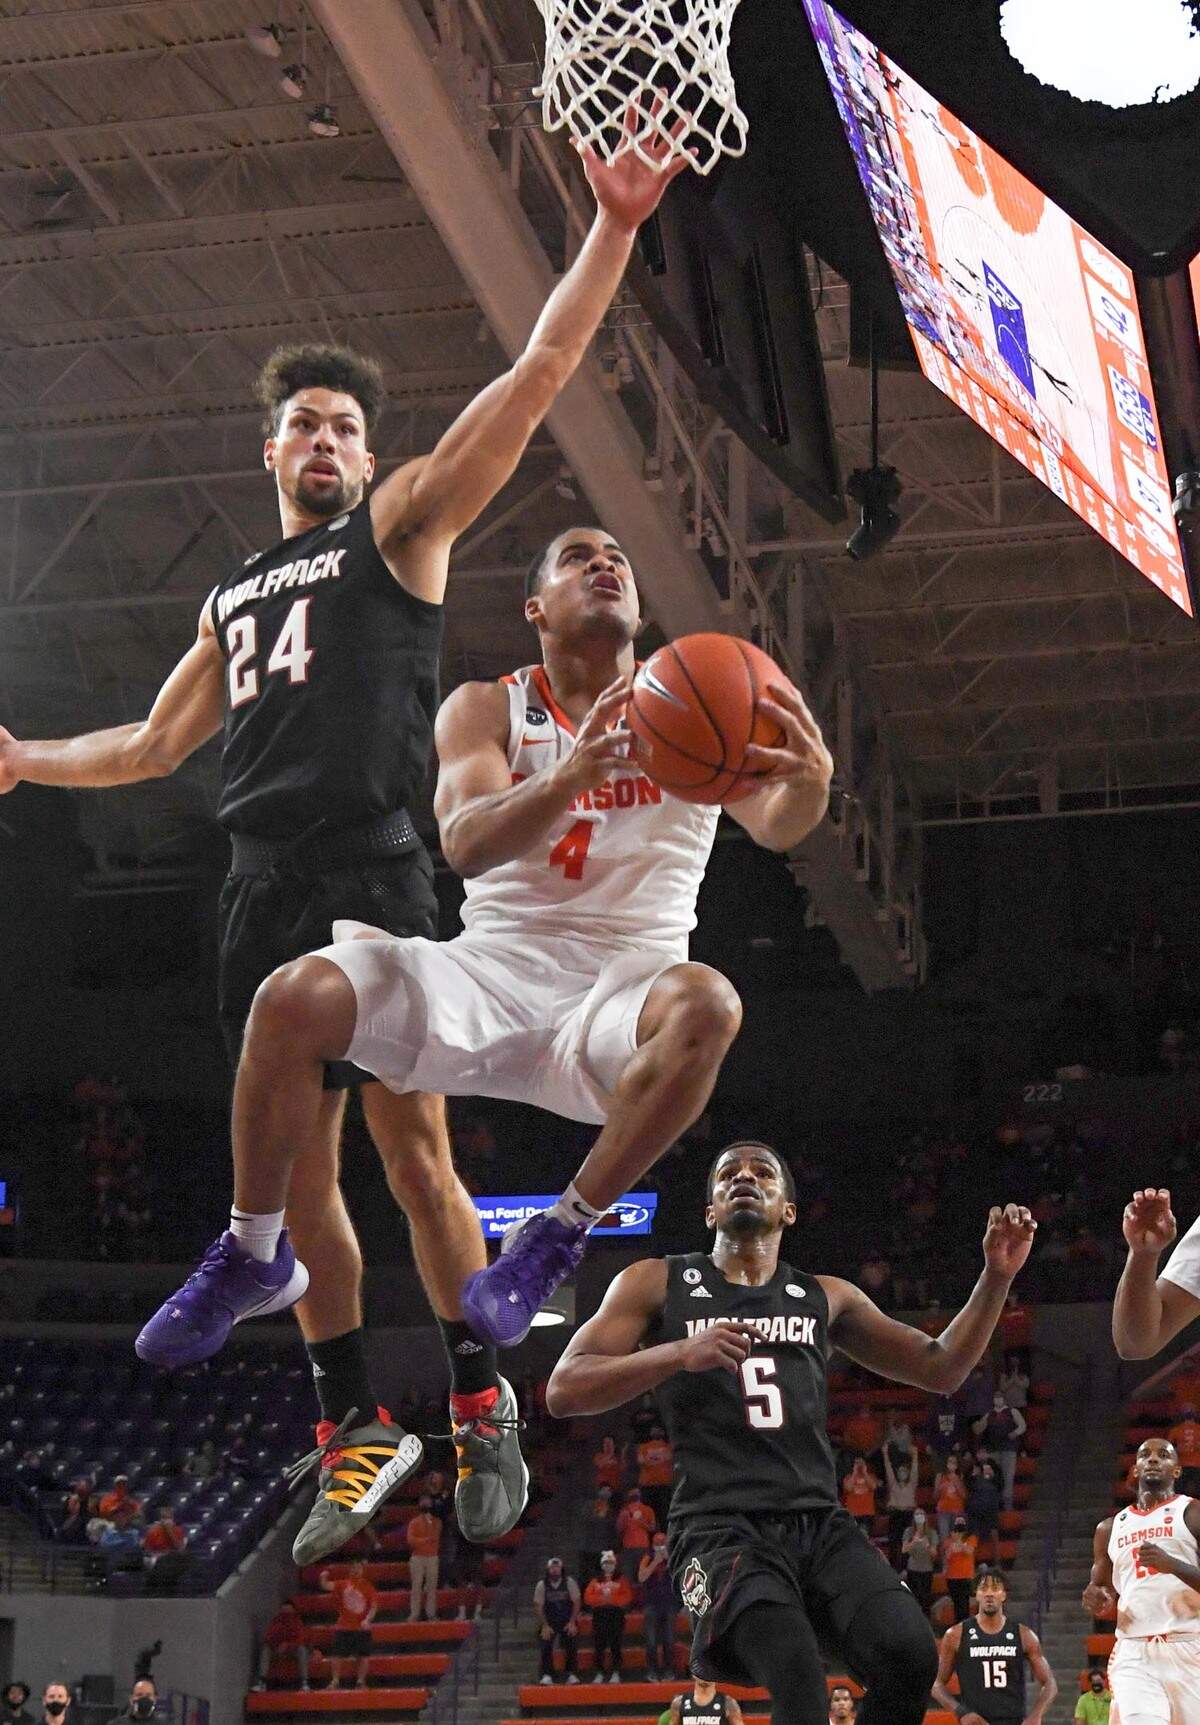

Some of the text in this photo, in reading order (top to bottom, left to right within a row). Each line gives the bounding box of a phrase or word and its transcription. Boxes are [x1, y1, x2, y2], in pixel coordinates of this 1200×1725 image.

[1101, 295, 1128, 334] 42
[1112, 370, 1145, 437] 15:55
[217, 549, 347, 624] WOLFPACK
[226, 596, 315, 710] 24
[549, 818, 594, 880] 4
[1023, 1083, 1062, 1102] 222
[496, 1207, 525, 1219] Ford
[740, 1356, 784, 1430] 5
[1117, 1526, 1173, 1549] CLEMSON
[969, 1645, 1017, 1658] WOLFPACK
[981, 1660, 1008, 1689] 15
